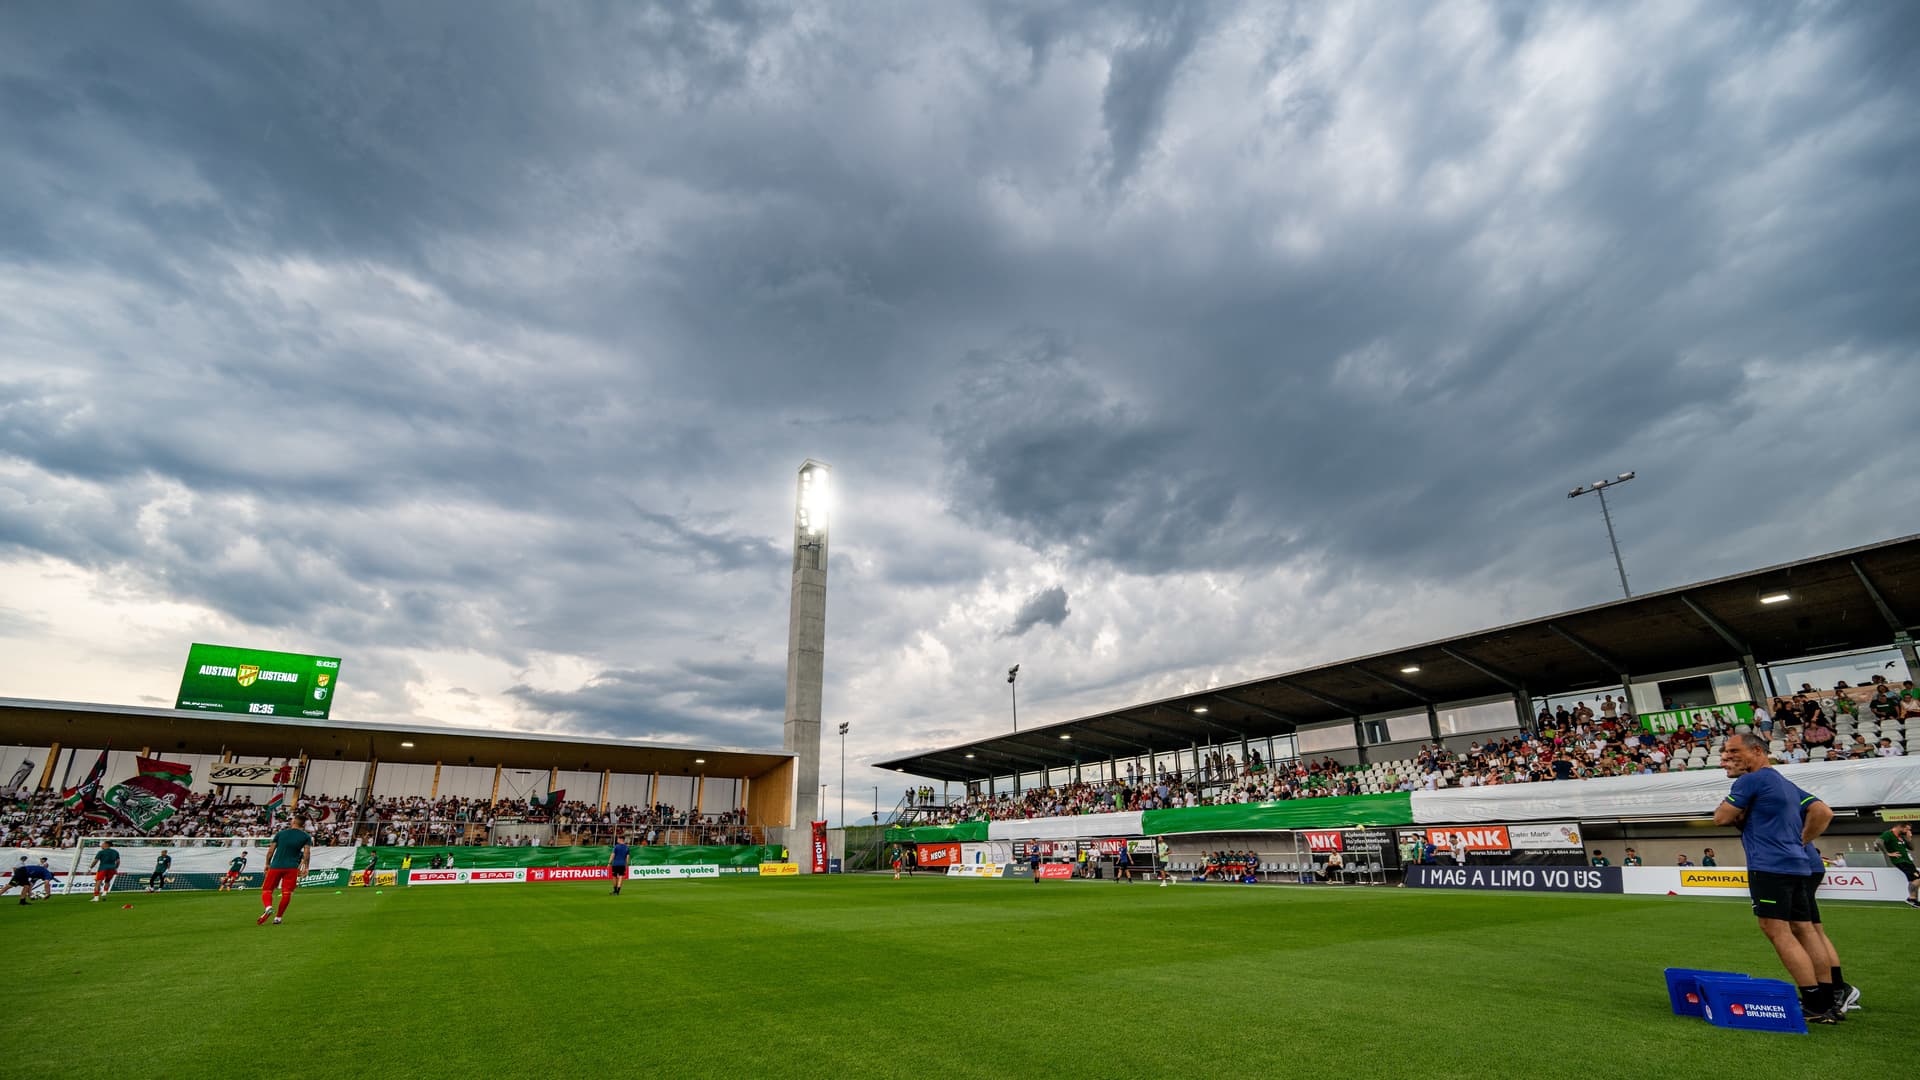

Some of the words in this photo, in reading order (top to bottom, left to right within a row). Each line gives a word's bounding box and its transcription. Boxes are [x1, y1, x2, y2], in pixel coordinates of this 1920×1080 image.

[199, 664, 237, 677] AUSTRIA
[258, 670, 298, 683] LUSTENAU
[249, 703, 275, 714] 16:35
[1649, 711, 1678, 733] EIN
[1431, 829, 1504, 847] BLANK
[418, 872, 457, 881] SPAR
[478, 871, 514, 880] SPAR
[550, 869, 608, 879] VERTRAUEN
[1421, 869, 1426, 885] I
[1430, 869, 1467, 886] MAG
[1472, 869, 1485, 886] A
[1491, 869, 1536, 887] LIMO
[1542, 870, 1569, 888] VO
[1574, 870, 1601, 889] ÜS
[1686, 874, 1750, 884] ADMIRAL
[1744, 1003, 1785, 1013] FRANKEN
[1746, 1010, 1787, 1020] BRUNNEN
